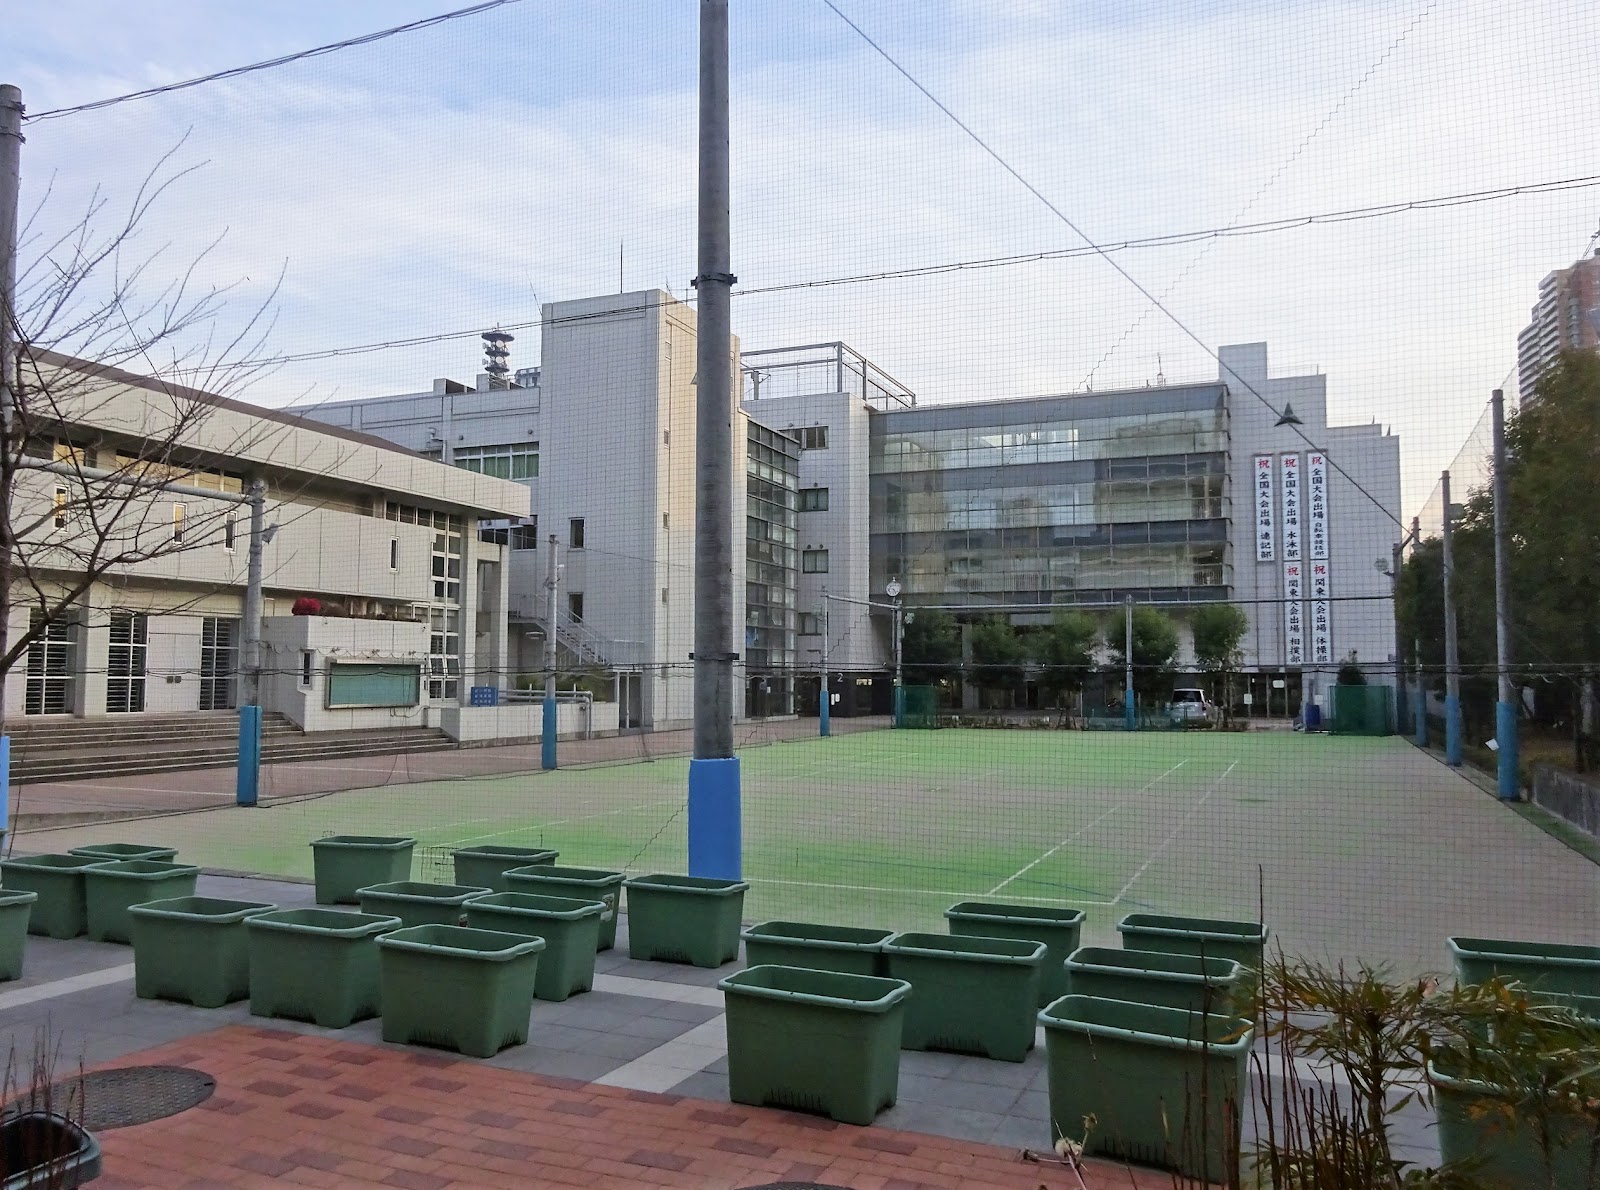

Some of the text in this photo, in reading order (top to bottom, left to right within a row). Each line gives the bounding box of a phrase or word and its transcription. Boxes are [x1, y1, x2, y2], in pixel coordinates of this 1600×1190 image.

[1258, 459, 1270, 469] 祝
[1311, 456, 1323, 465] 祝
[1312, 468, 1324, 519] 全国大会出場
[1259, 472, 1271, 527] 全国大会出場
[1284, 458, 1299, 557] 祝 全国大会出場 水泳部
[1287, 565, 1299, 576] 祝
[1313, 564, 1326, 575] 祝
